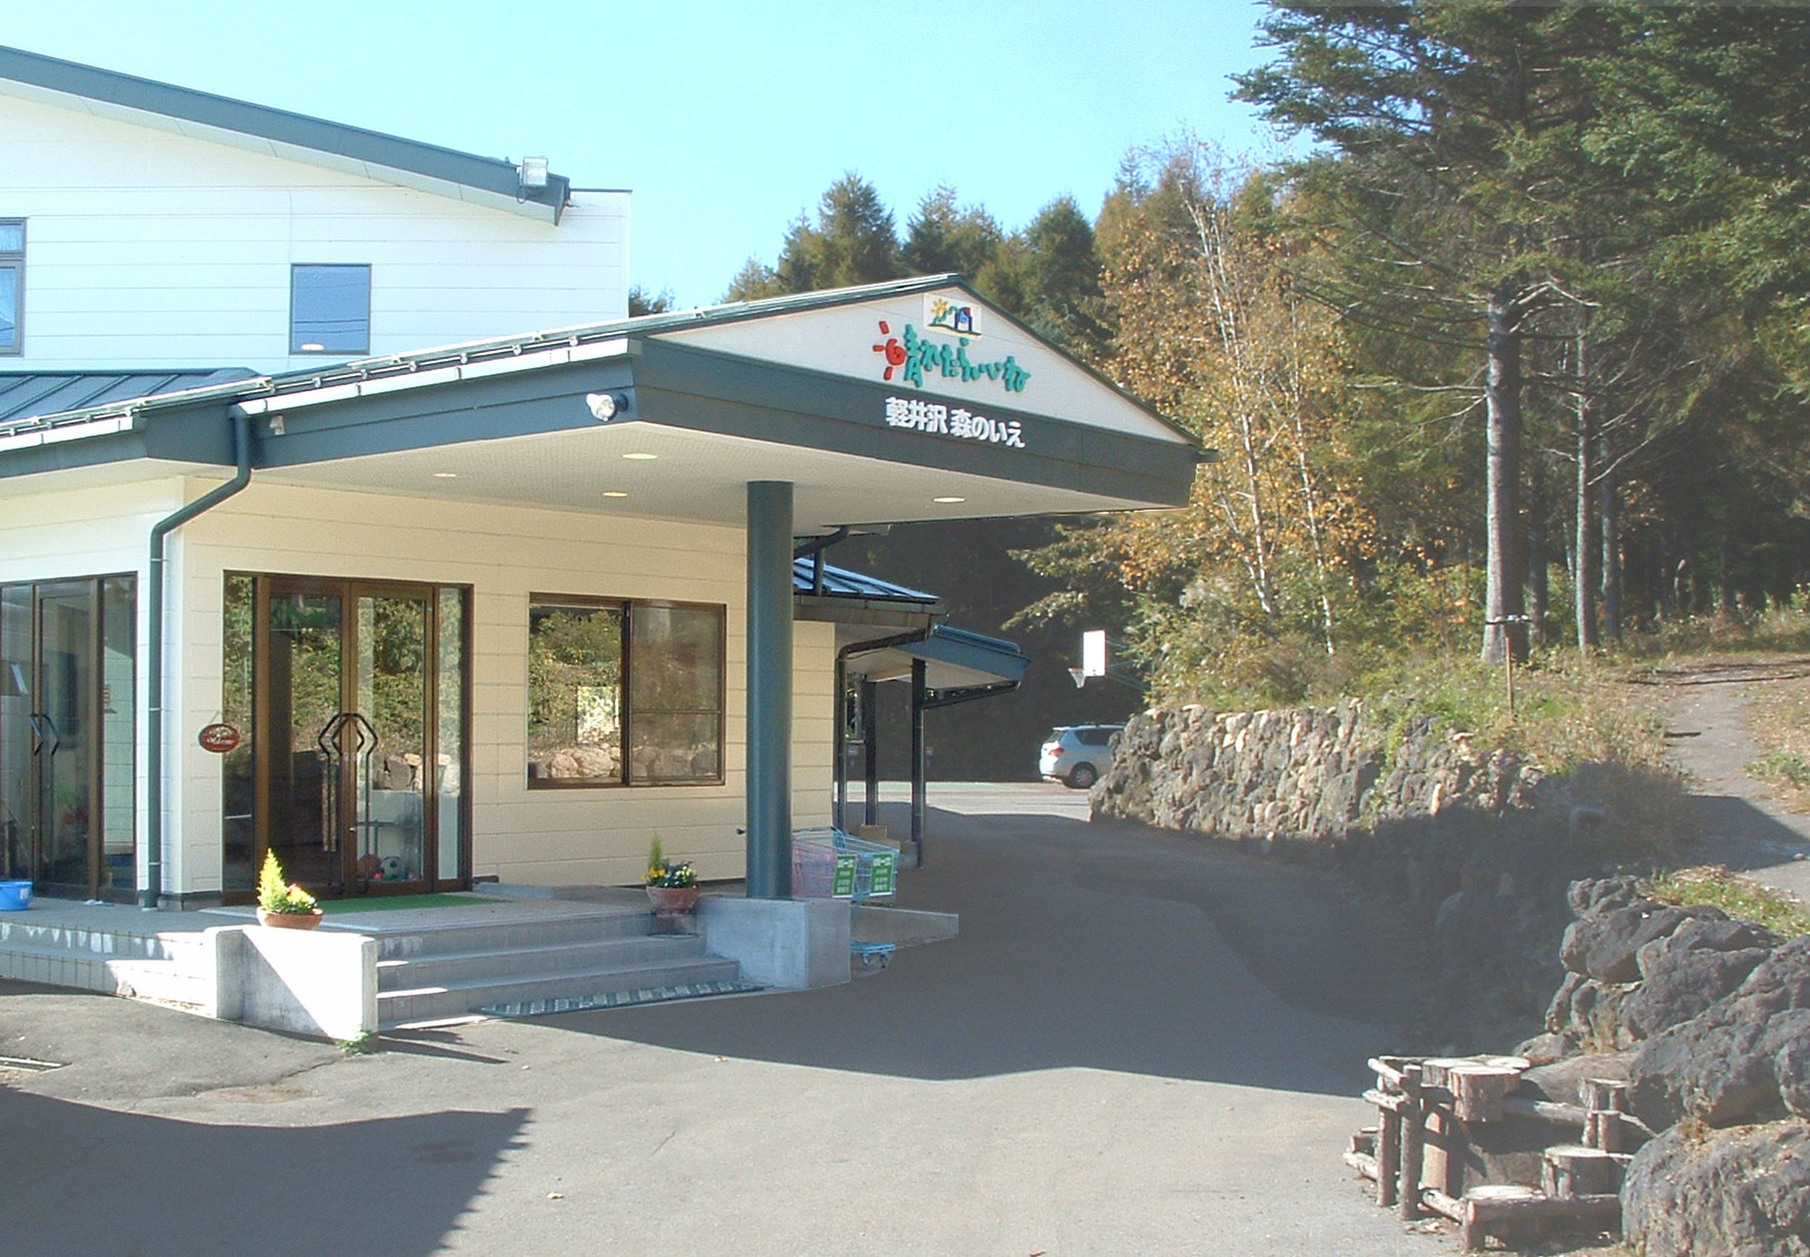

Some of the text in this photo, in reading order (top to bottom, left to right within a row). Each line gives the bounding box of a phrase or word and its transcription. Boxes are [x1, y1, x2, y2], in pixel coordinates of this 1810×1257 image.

[885, 396, 1025, 448] 軽井沢 森のいえ
